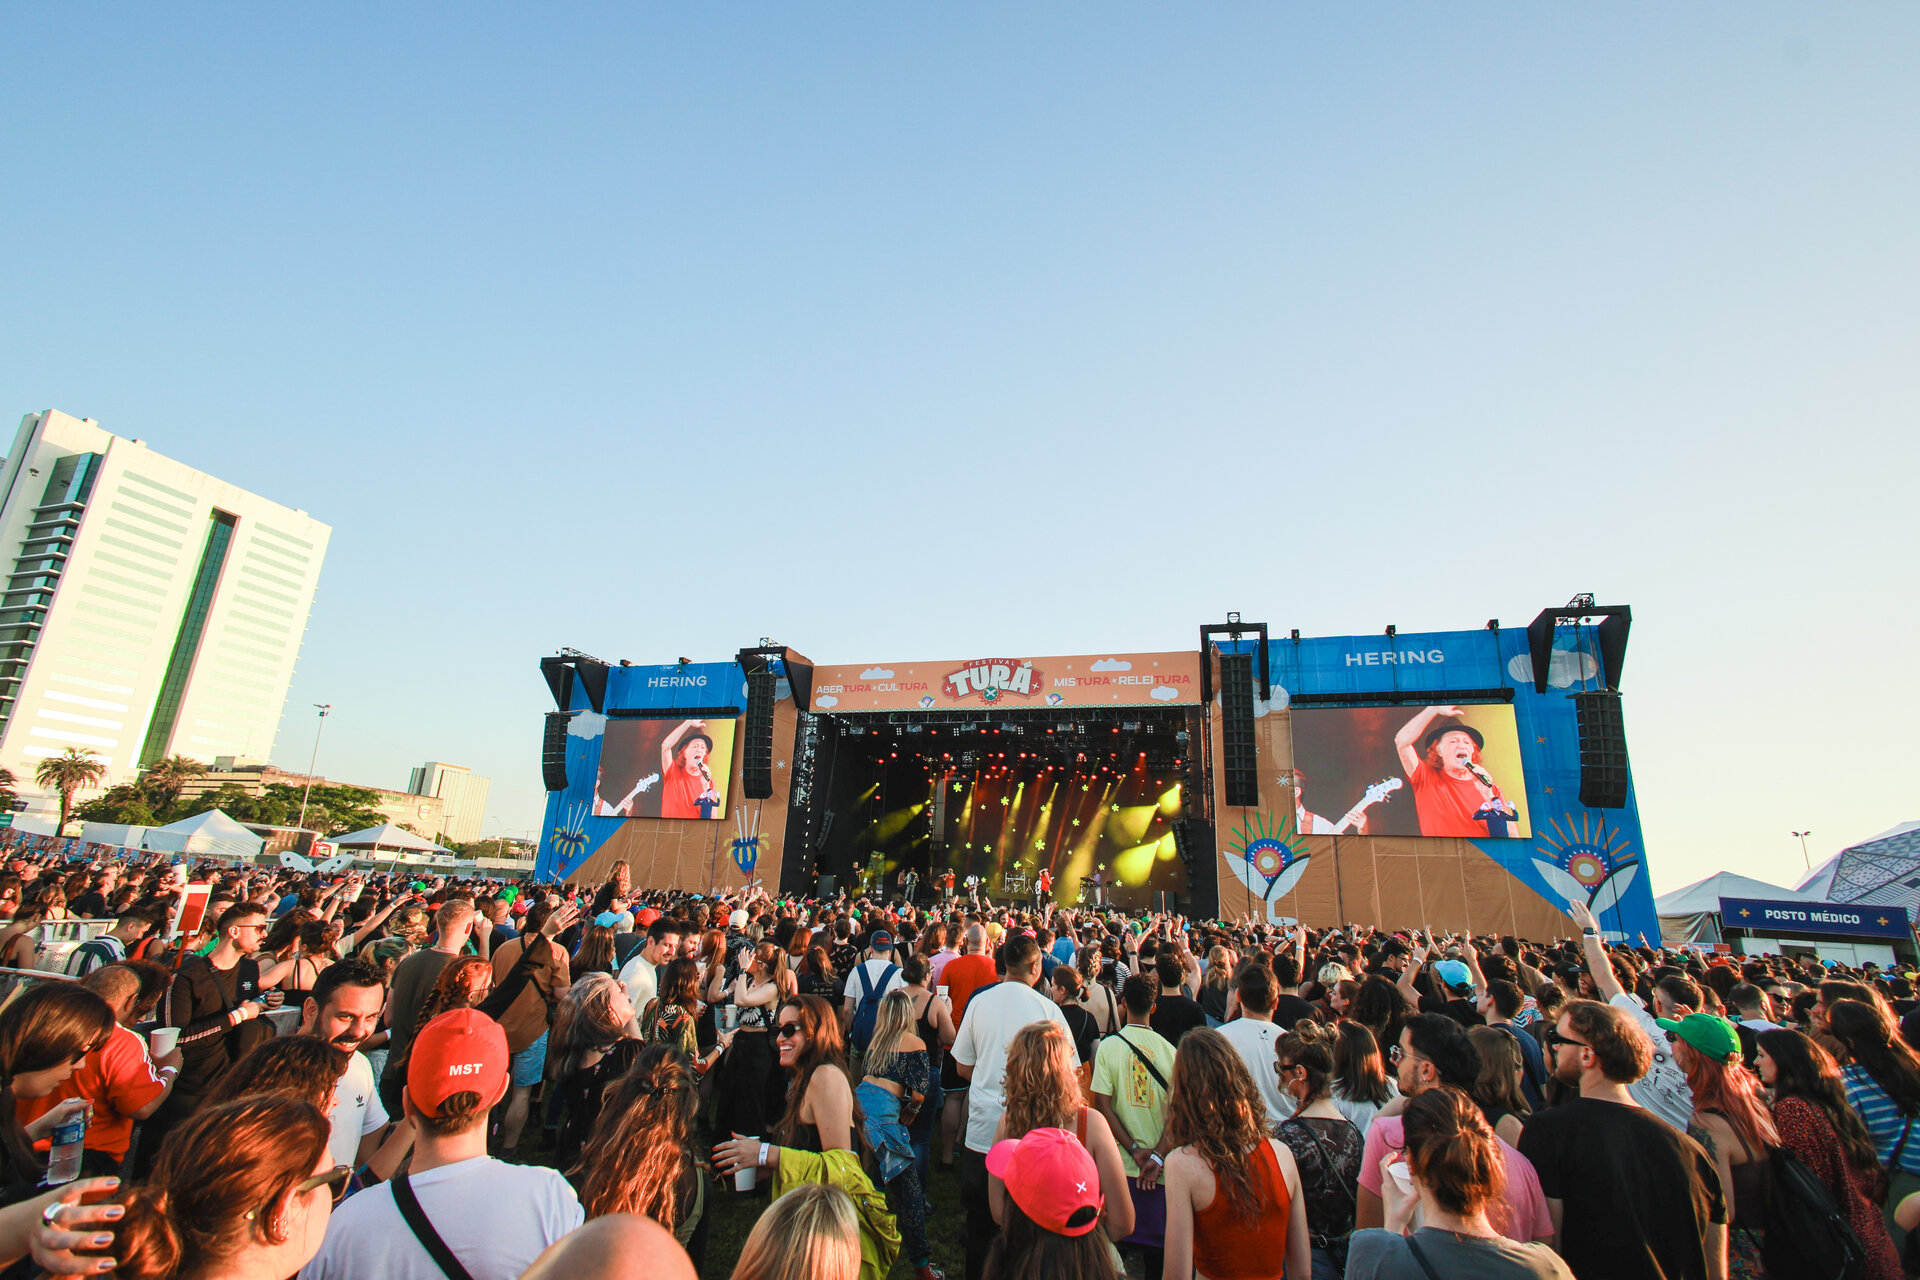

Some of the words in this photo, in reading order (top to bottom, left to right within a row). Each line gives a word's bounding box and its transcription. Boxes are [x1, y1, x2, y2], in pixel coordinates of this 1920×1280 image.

[968, 659, 1016, 667] FESTIVAL
[1345, 649, 1445, 667] HERING
[647, 675, 707, 688] HERING
[948, 660, 1033, 697] TURÁ
[1054, 676, 1111, 687] MISTURA
[1118, 674, 1191, 685] RELEITURA
[816, 684, 872, 694] ABERTURA
[878, 682, 929, 692] CULTURA
[1765, 909, 1807, 921] POSTO
[1810, 910, 1861, 925] MÉDICO
[449, 1063, 483, 1077] MST
